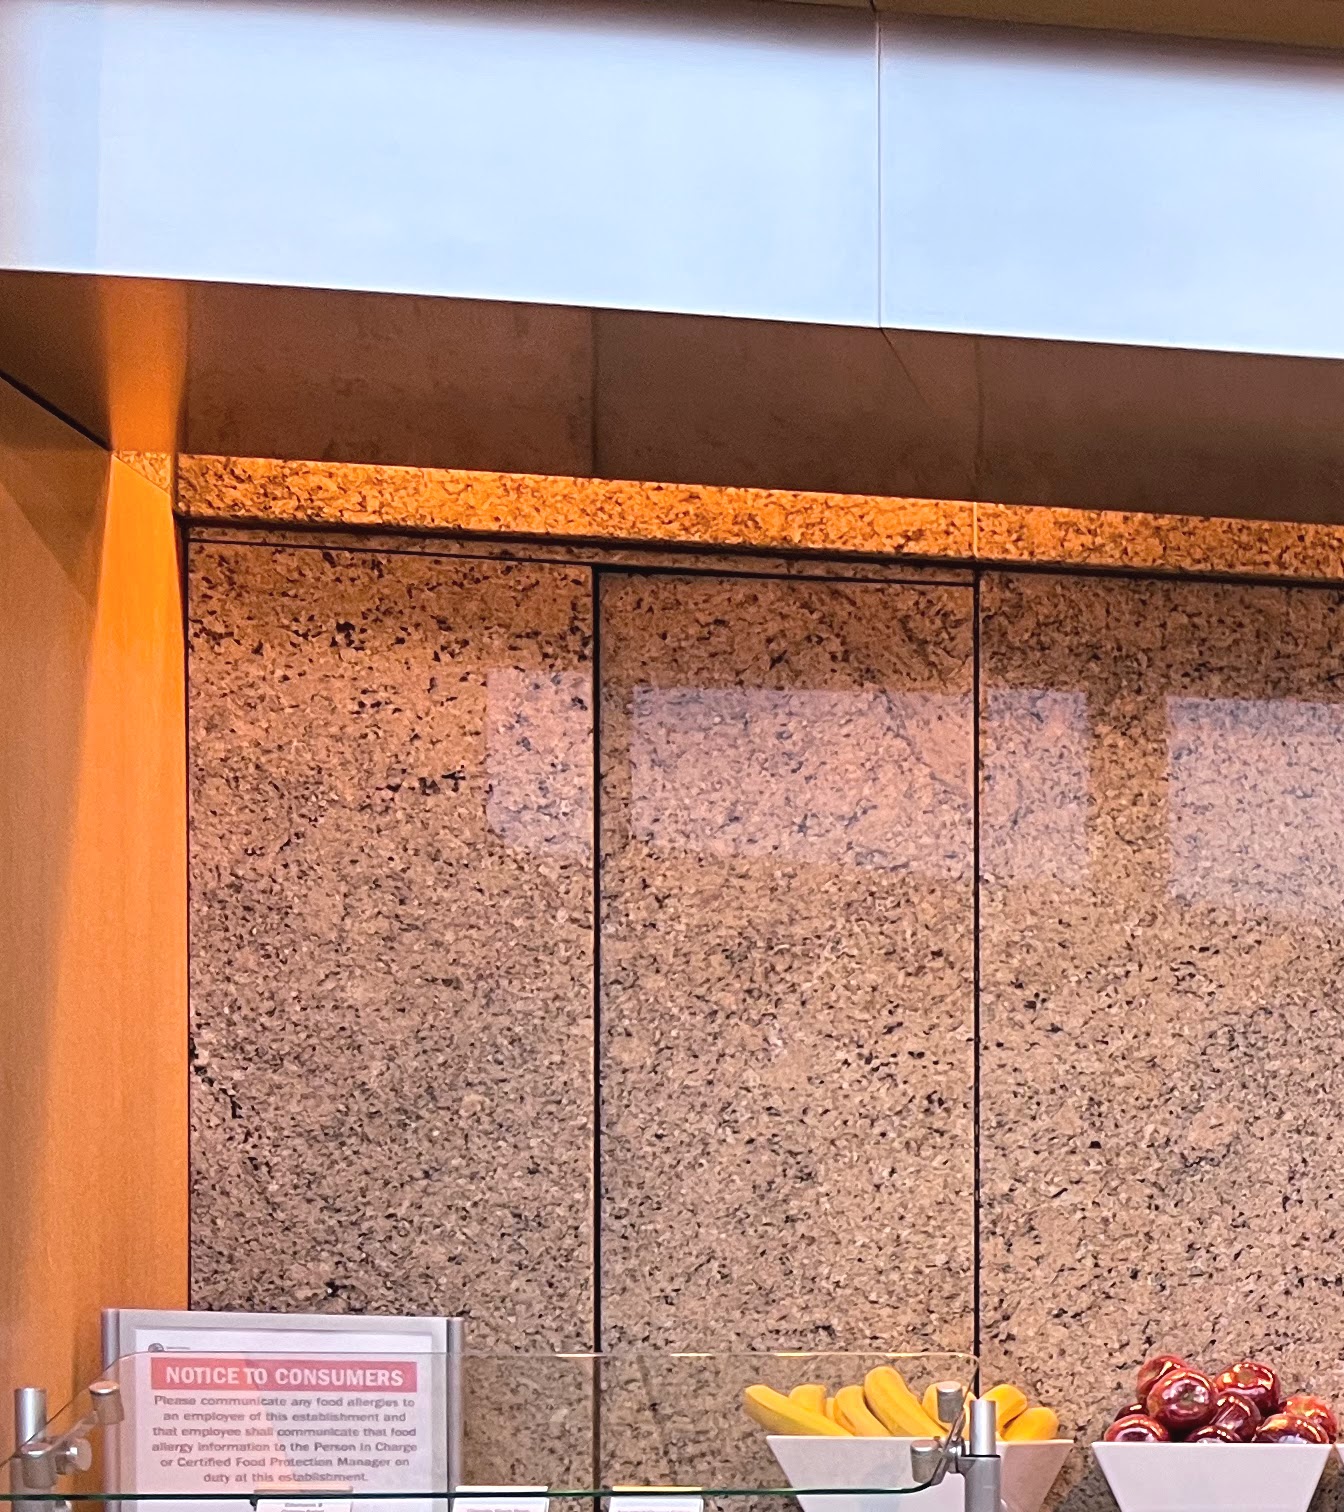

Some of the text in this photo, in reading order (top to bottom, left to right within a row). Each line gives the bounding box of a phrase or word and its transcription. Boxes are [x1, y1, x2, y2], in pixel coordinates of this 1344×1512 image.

[165, 1365, 404, 1387] NOTICE TO CONSUMERS
[154, 1395, 415, 1409] Please communicate any food allergies to
[163, 1411, 406, 1423] an employee of this establishment and
[152, 1426, 417, 1438] that employee shall communicate that food
[151, 1442, 418, 1454] allergy information to the Person in Charge
[159, 1457, 410, 1468] or Certified Food Protection Manager on
[203, 1473, 230, 1484] duty
[234, 1473, 248, 1483] at
[251, 1473, 274, 1483] this
